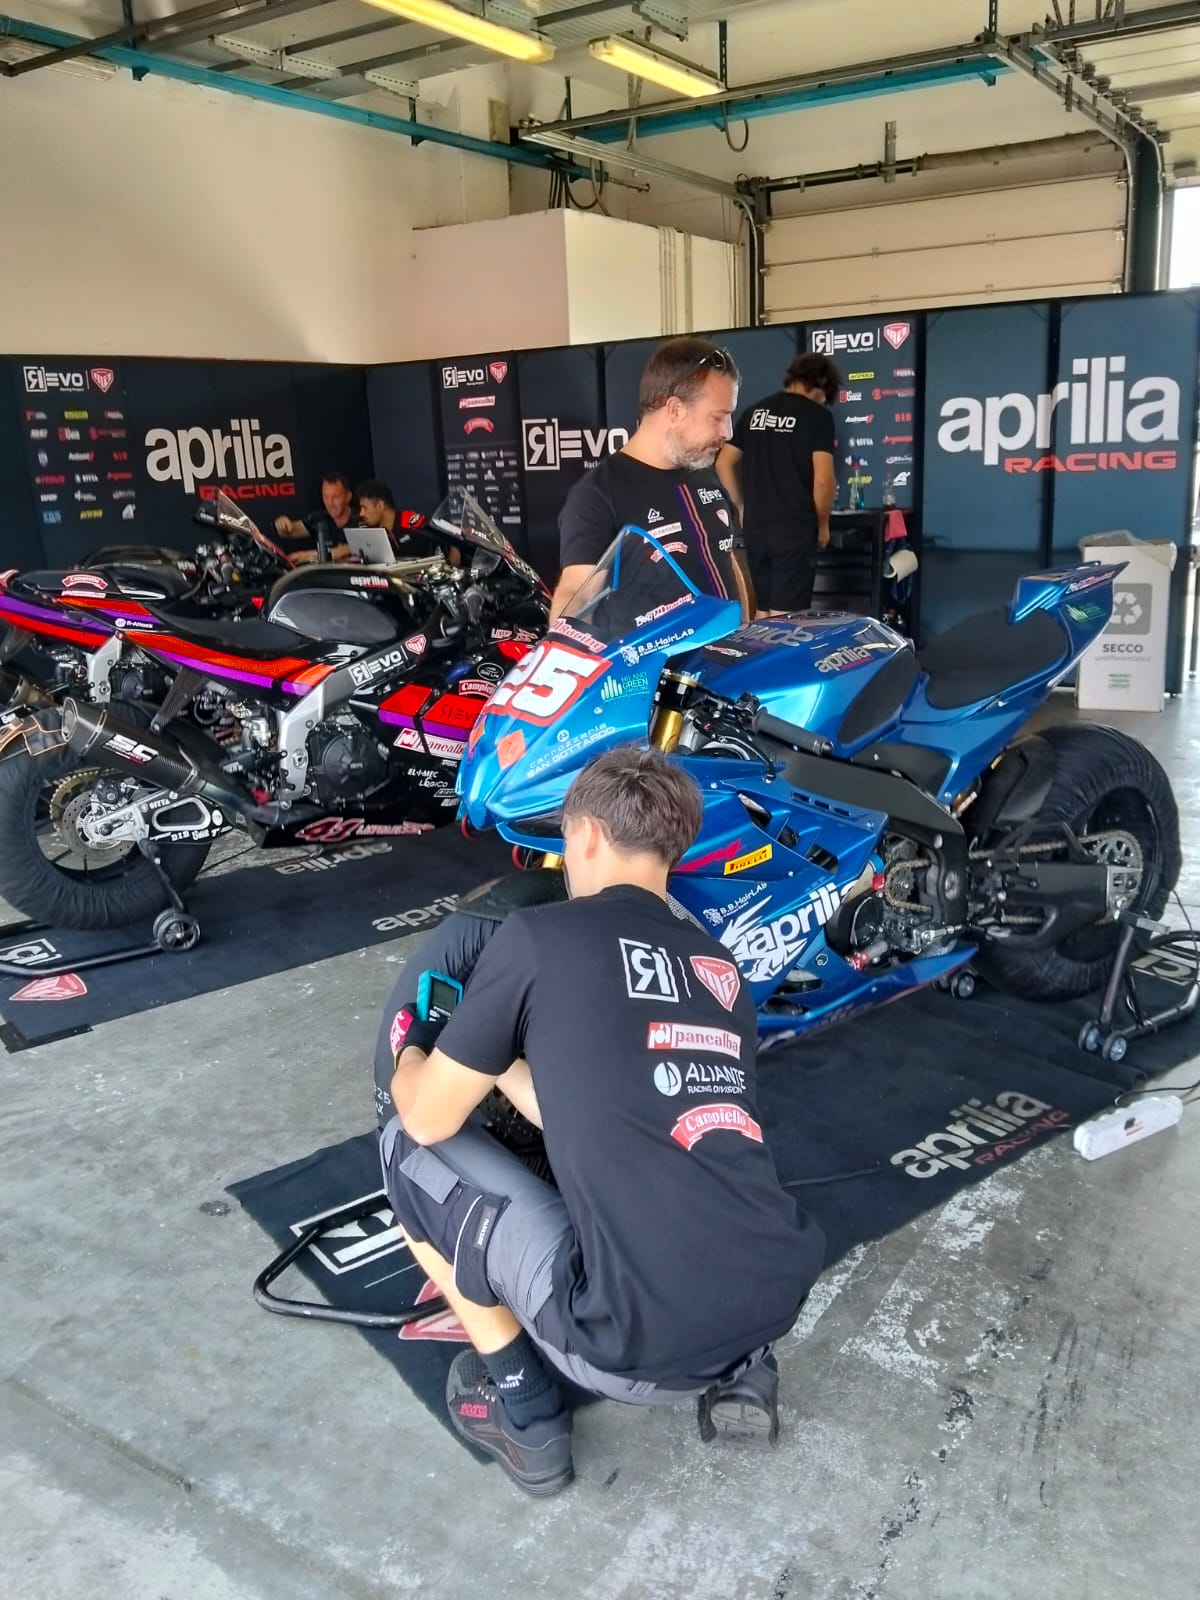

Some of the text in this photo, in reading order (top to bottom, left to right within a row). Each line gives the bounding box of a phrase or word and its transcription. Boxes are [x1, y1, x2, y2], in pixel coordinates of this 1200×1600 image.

[937, 356, 1180, 466] aprilia
[144, 419, 294, 494] aprilia
[1004, 450, 1177, 473] RACING
[199, 483, 295, 500] RACING
[350, 576, 388, 587] aprilia
[815, 646, 871, 673] aprilia
[1103, 643, 1144, 653] SECCO
[486, 645, 601, 718] 25
[623, 677, 648, 689] GREEN
[746, 880, 857, 960] aprili
[685, 1062, 746, 1090] ALIANTE
[687, 1085, 743, 1095] RACING DIVISION
[685, 1107, 747, 1132] Campiello
[890, 1091, 1053, 1179] aprilia
[973, 1110, 1071, 1166] RACING
